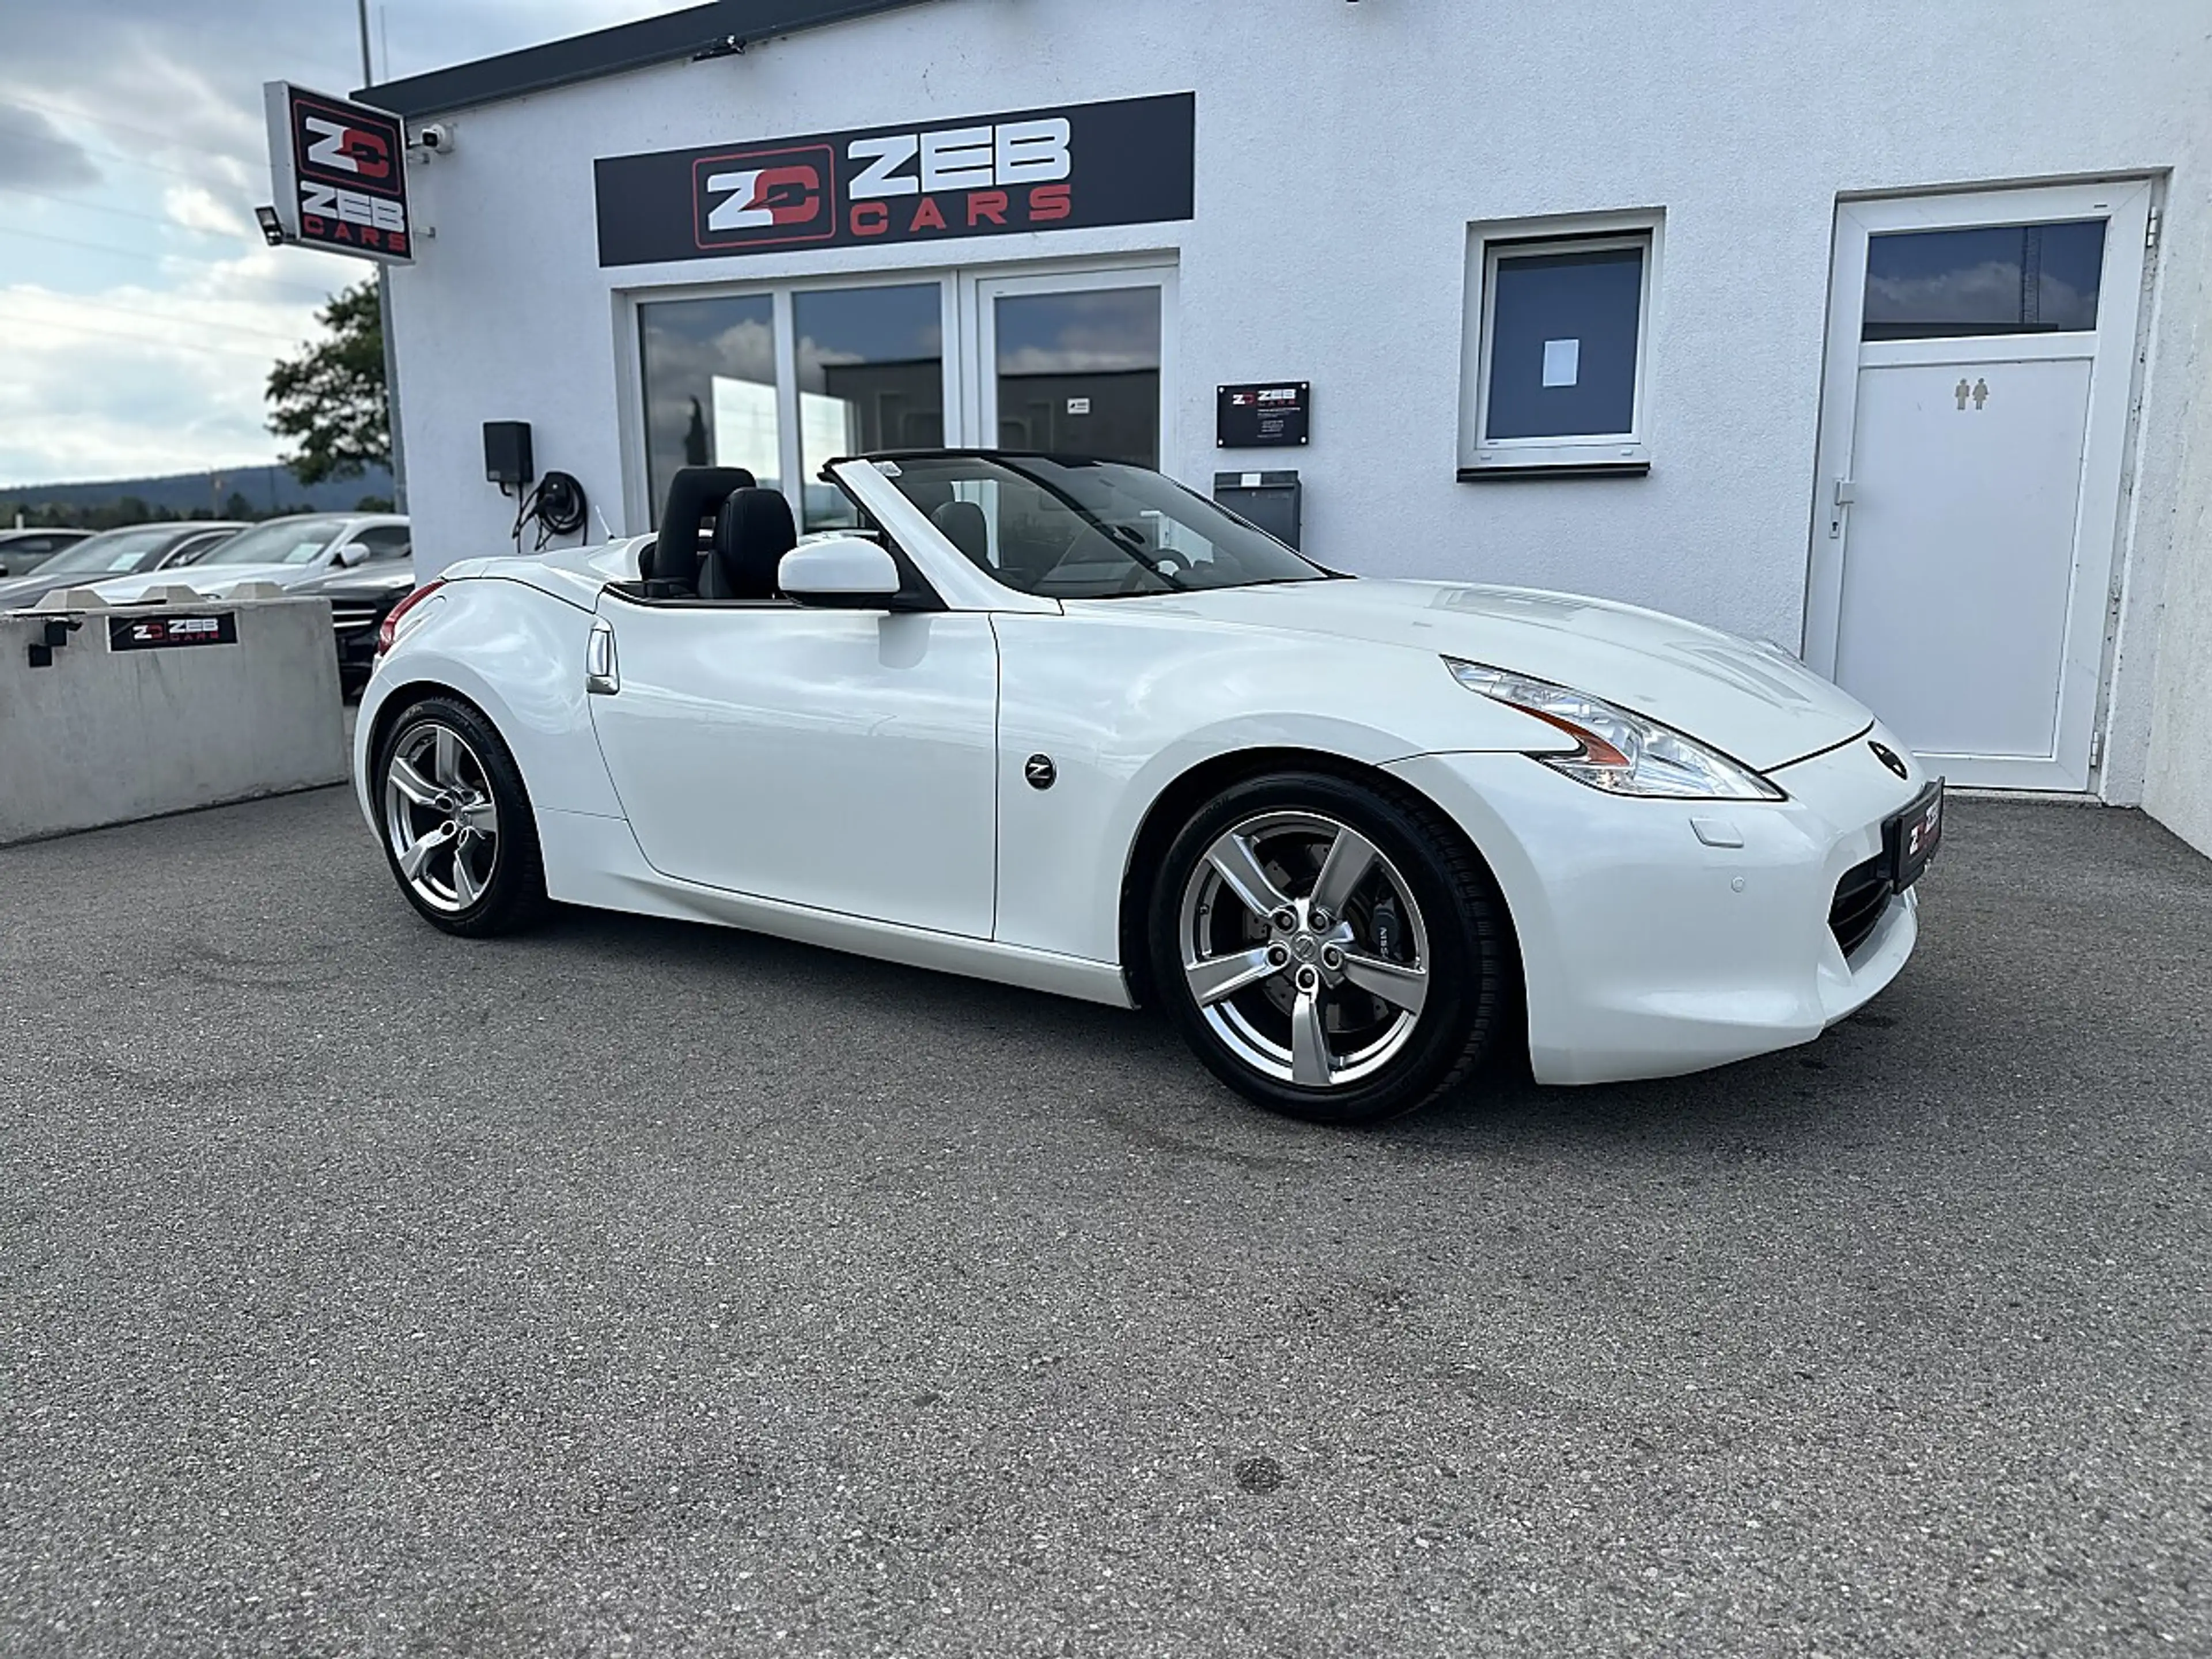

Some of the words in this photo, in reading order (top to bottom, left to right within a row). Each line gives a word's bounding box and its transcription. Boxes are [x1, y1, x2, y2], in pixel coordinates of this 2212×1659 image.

[847, 117, 1071, 200] ZEB
[300, 180, 405, 233] ZEB
[304, 214, 406, 251] CARS
[850, 184, 1071, 236] CARS
[168, 618, 218, 633] ZEB
